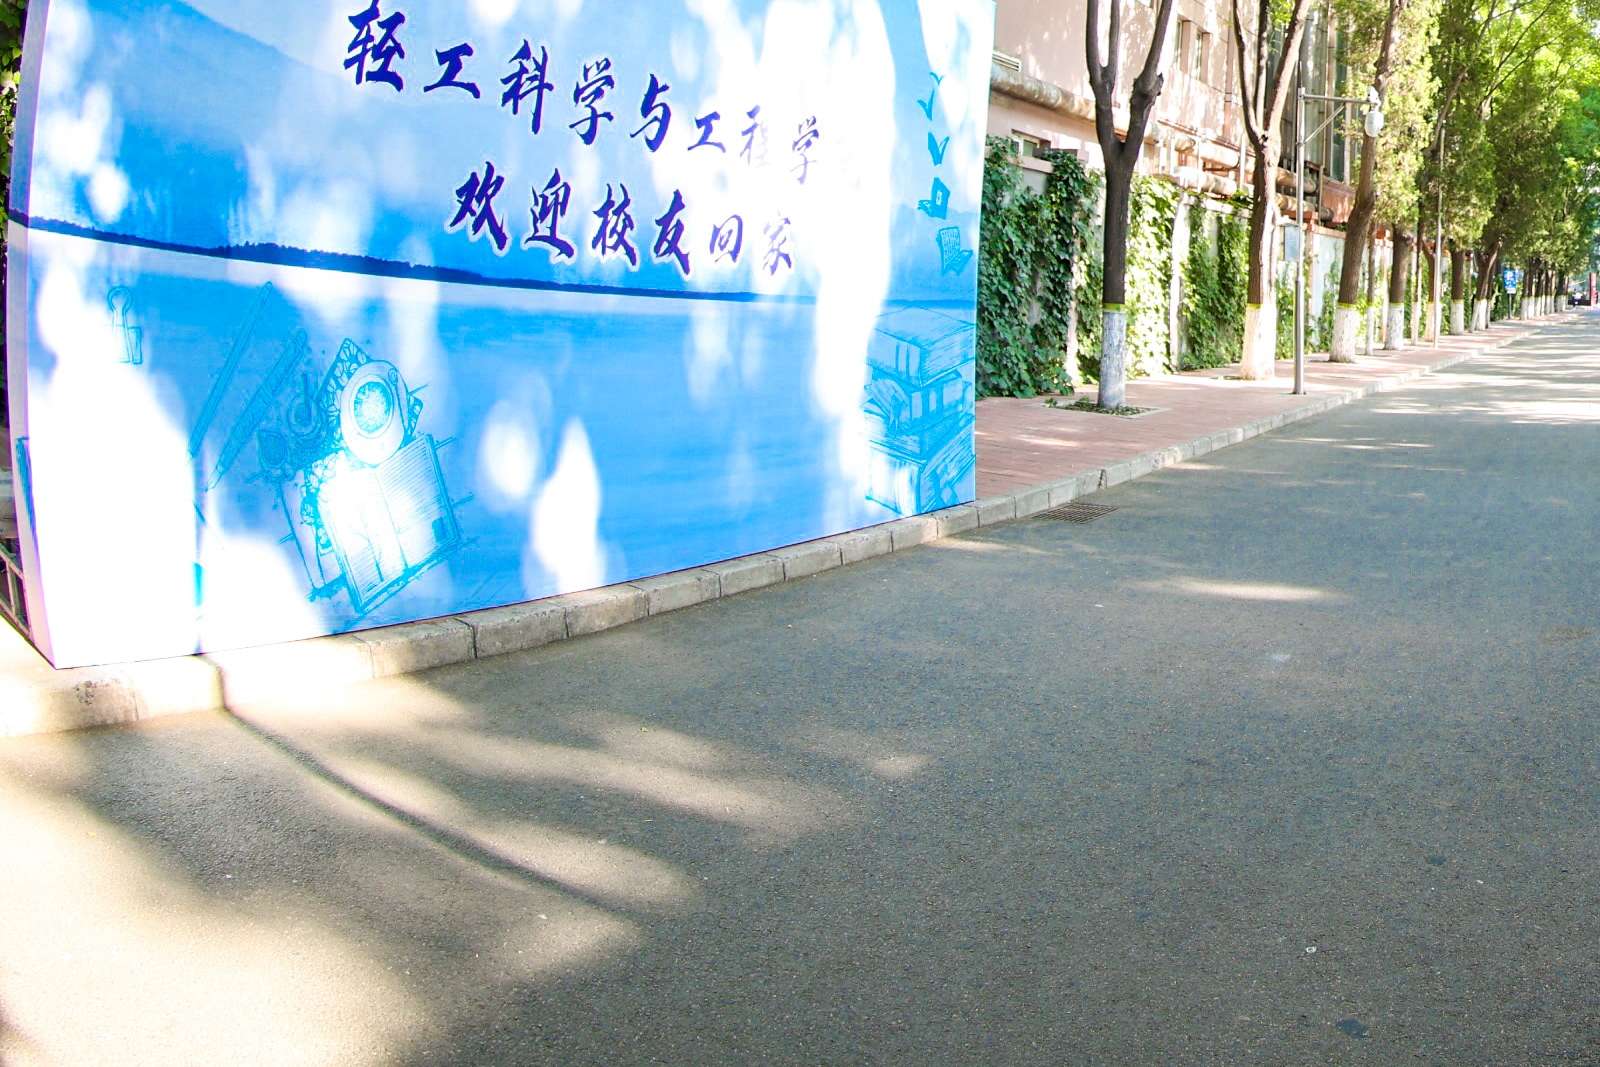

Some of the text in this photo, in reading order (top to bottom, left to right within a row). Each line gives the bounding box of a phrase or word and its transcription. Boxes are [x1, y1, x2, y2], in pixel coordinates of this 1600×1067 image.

[449, 161, 795, 276] 欢迎校友回家
